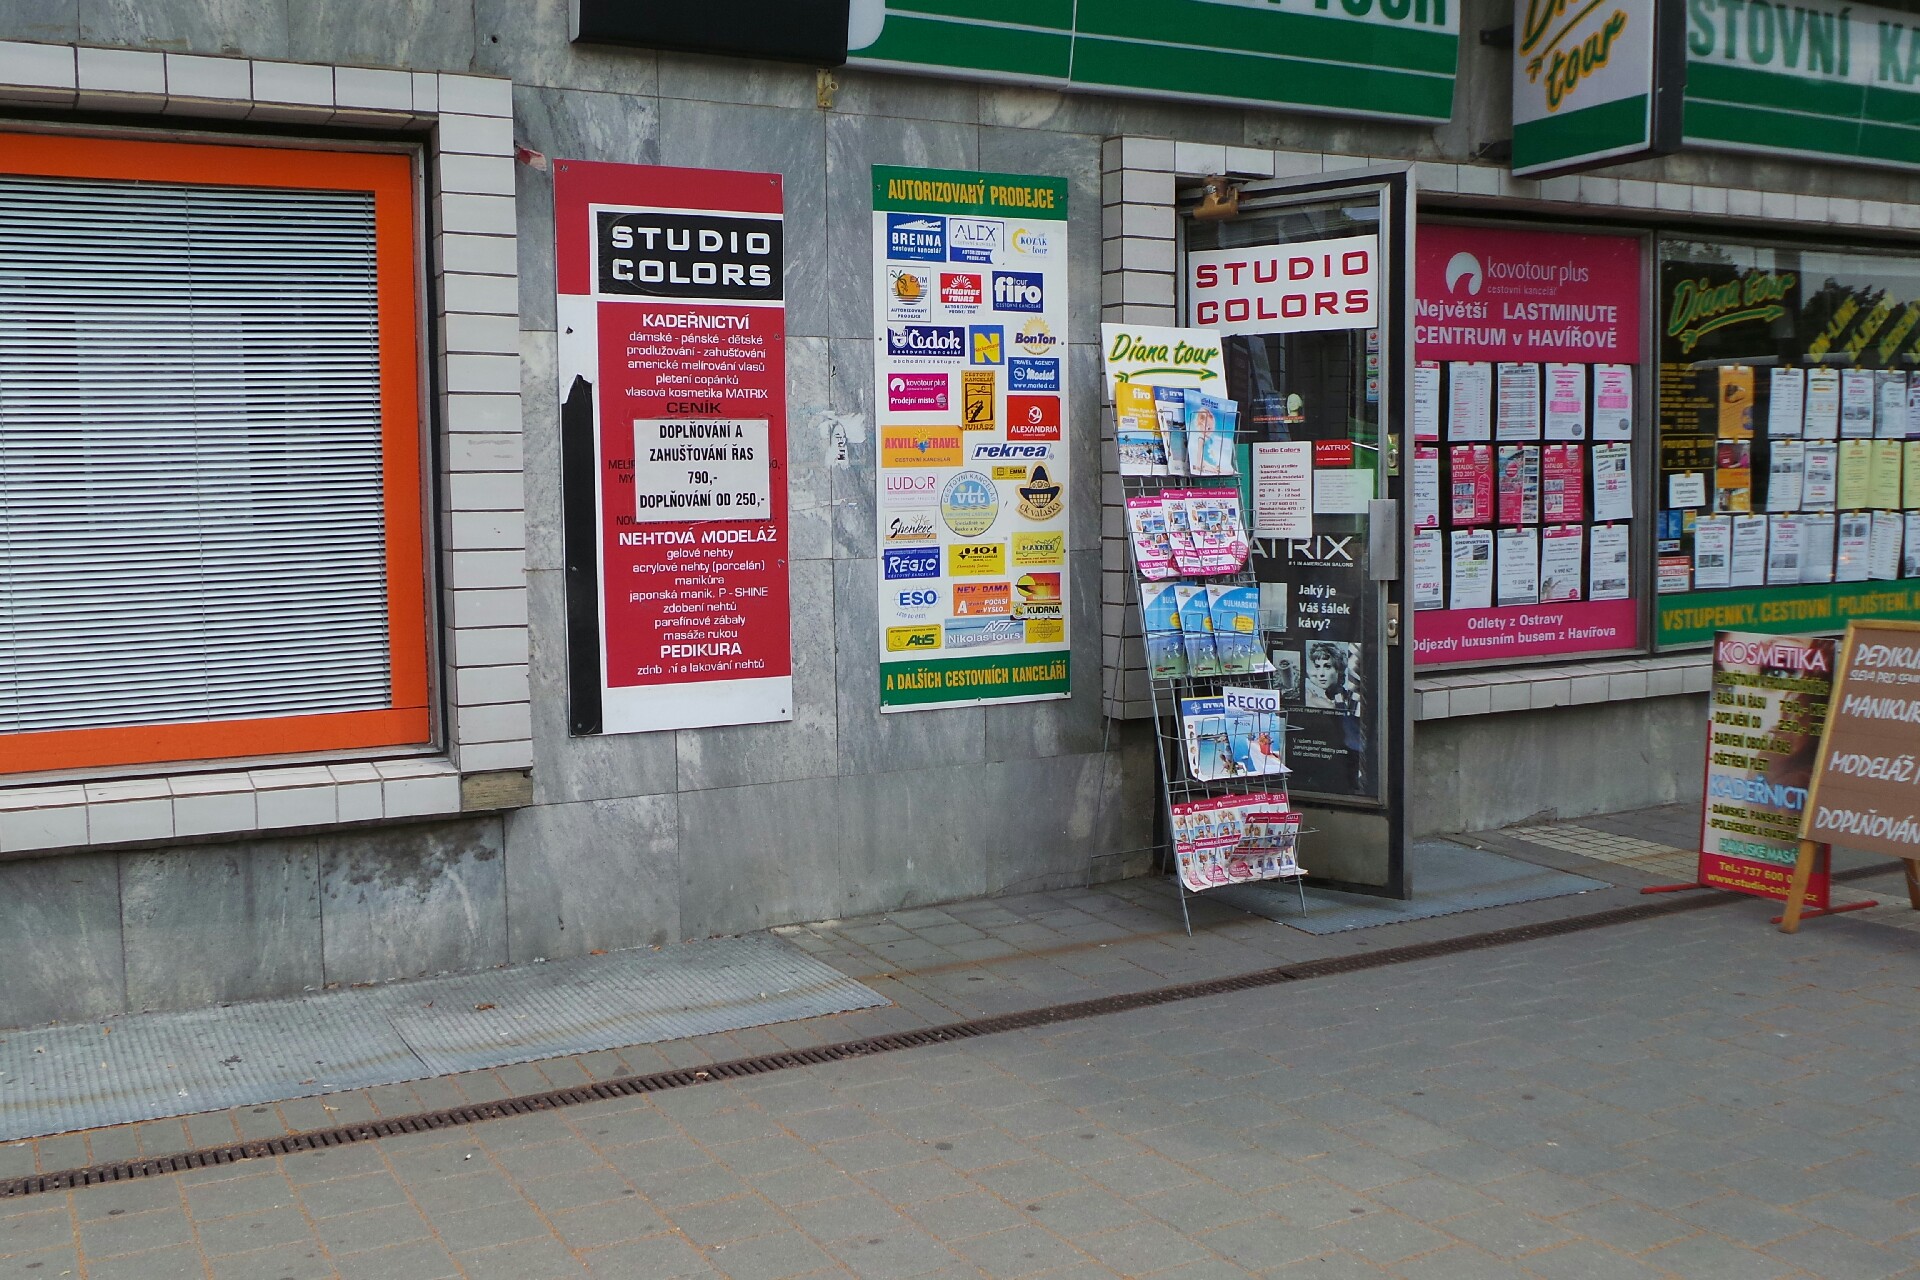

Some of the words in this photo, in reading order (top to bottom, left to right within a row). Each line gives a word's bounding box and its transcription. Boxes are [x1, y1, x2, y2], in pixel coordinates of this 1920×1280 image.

[1544, 9, 1628, 112] tour
[889, 179, 984, 204] AUTORIZOVANÝ
[990, 185, 1054, 208] PRODEJCE
[611, 225, 771, 255] STUDIO
[892, 232, 941, 247] BRENNA
[955, 225, 995, 241] ALEX
[612, 258, 771, 286] COLORS
[1196, 251, 1369, 288] STUDIO
[1488, 256, 1555, 280] kovotour
[1559, 261, 1589, 286] plus
[995, 277, 1041, 303] firo
[1488, 285, 1520, 294] cestovní
[1524, 286, 1558, 296] kancelář
[1197, 289, 1369, 324] COLORS
[1415, 298, 1488, 321] Největší
[1503, 302, 1617, 323] LASTMINUTE
[1668, 278, 1741, 337] Diana
[1744, 270, 1795, 306] tour
[643, 311, 749, 330] KADEŘNICTVÍ
[630, 333, 672, 342] dámské
[681, 334, 719, 345] pánské
[728, 334, 763, 345] dětské
[909, 329, 961, 349] Čedok
[1015, 333, 1056, 344] BonTon
[1415, 325, 1506, 345] CENTRUM
[1513, 334, 1522, 345] v
[1528, 325, 1616, 348] HAVÍŘOVĚ
[627, 346, 695, 357] prodlužování
[703, 347, 766, 358] zahušťování
[1108, 333, 1169, 363] Diana
[1173, 339, 1219, 365] tour
[628, 360, 678, 370] americké
[681, 360, 736, 371] melírování
[739, 361, 765, 371] vlasů
[656, 375, 692, 385] pletení
[695, 375, 739, 385] copánků
[626, 388, 666, 397] vlasová
[669, 388, 722, 398] kosmetika
[726, 388, 768, 399] MATRIX
[891, 397, 916, 405] Prodejní
[1133, 388, 1150, 399] firo
[666, 400, 721, 413] CENÍK
[660, 421, 731, 438] DOPLŇOVÁNÍ
[735, 425, 743, 437] A
[885, 437, 918, 449] AKVILA
[928, 438, 959, 448] TRAVEL
[975, 444, 1046, 457] rekrea
[650, 444, 727, 461] ZAHUŠŤOVÁNÍ
[732, 445, 753, 460] ŘAS
[688, 471, 718, 485] 790,-
[887, 477, 935, 490] LUDOR
[640, 491, 711, 508] DOPLŇOVÁNÍ
[717, 493, 731, 506] OD
[736, 493, 764, 506] 250,-
[955, 486, 985, 503] vtt
[619, 528, 695, 546] NEHTOVÁ
[702, 526, 776, 543] MODELÁŽ
[667, 548, 700, 560] gelové
[704, 549, 733, 559] nehty
[1249, 536, 1353, 560] ATRIX
[633, 562, 677, 574] acrylové
[681, 561, 709, 573] nehty
[712, 560, 764, 573] (porcelán)
[888, 556, 936, 573] RÉGIO
[630, 590, 677, 603] japonská
[681, 589, 715, 599] manik.
[719, 588, 726, 597] P
[735, 587, 768, 597] SHINE
[900, 591, 937, 606] ESO
[1299, 585, 1323, 597] Jaký
[1326, 585, 1336, 598] je
[663, 603, 703, 613] zdobení
[707, 602, 736, 611] nehtů
[1223, 600, 1257, 608] BULHARSKO
[1299, 602, 1318, 613] Váš
[1321, 603, 1350, 614] šálek
[1663, 604, 1758, 630] VSTUPENKY,
[1760, 593, 1833, 622] CESTOVNÍ
[655, 617, 710, 629] parafínové
[714, 615, 745, 626] zábaly
[1299, 617, 1330, 631] kávy?
[1468, 616, 1506, 630] Odlety
[1510, 618, 1515, 626] z
[1520, 614, 1563, 626] Ostravy
[663, 629, 704, 640] masáže
[708, 630, 737, 639] rukou
[948, 631, 989, 644] Nikolas
[992, 631, 1021, 641] tours
[1462, 634, 1514, 648] luxusním
[1518, 630, 1555, 643] busem
[1559, 631, 1564, 639] z
[1568, 625, 1616, 639] Havířova
[661, 643, 742, 658] PEDIKURA
[1719, 641, 1826, 671] KOSMETIKA
[690, 660, 732, 672] lakování
[735, 660, 764, 669] nehtů
[887, 675, 893, 690] A
[898, 668, 941, 690] DALŠÍCH
[946, 665, 1008, 687] CESTOVNÍCH
[1013, 660, 1066, 683] KANCELÁŘÍ
[1227, 692, 1276, 710] ŘECKO
[1829, 750, 1915, 782] MODELÁŽ
[1743, 866, 1762, 877] 737
[1765, 869, 1783, 881] 600
